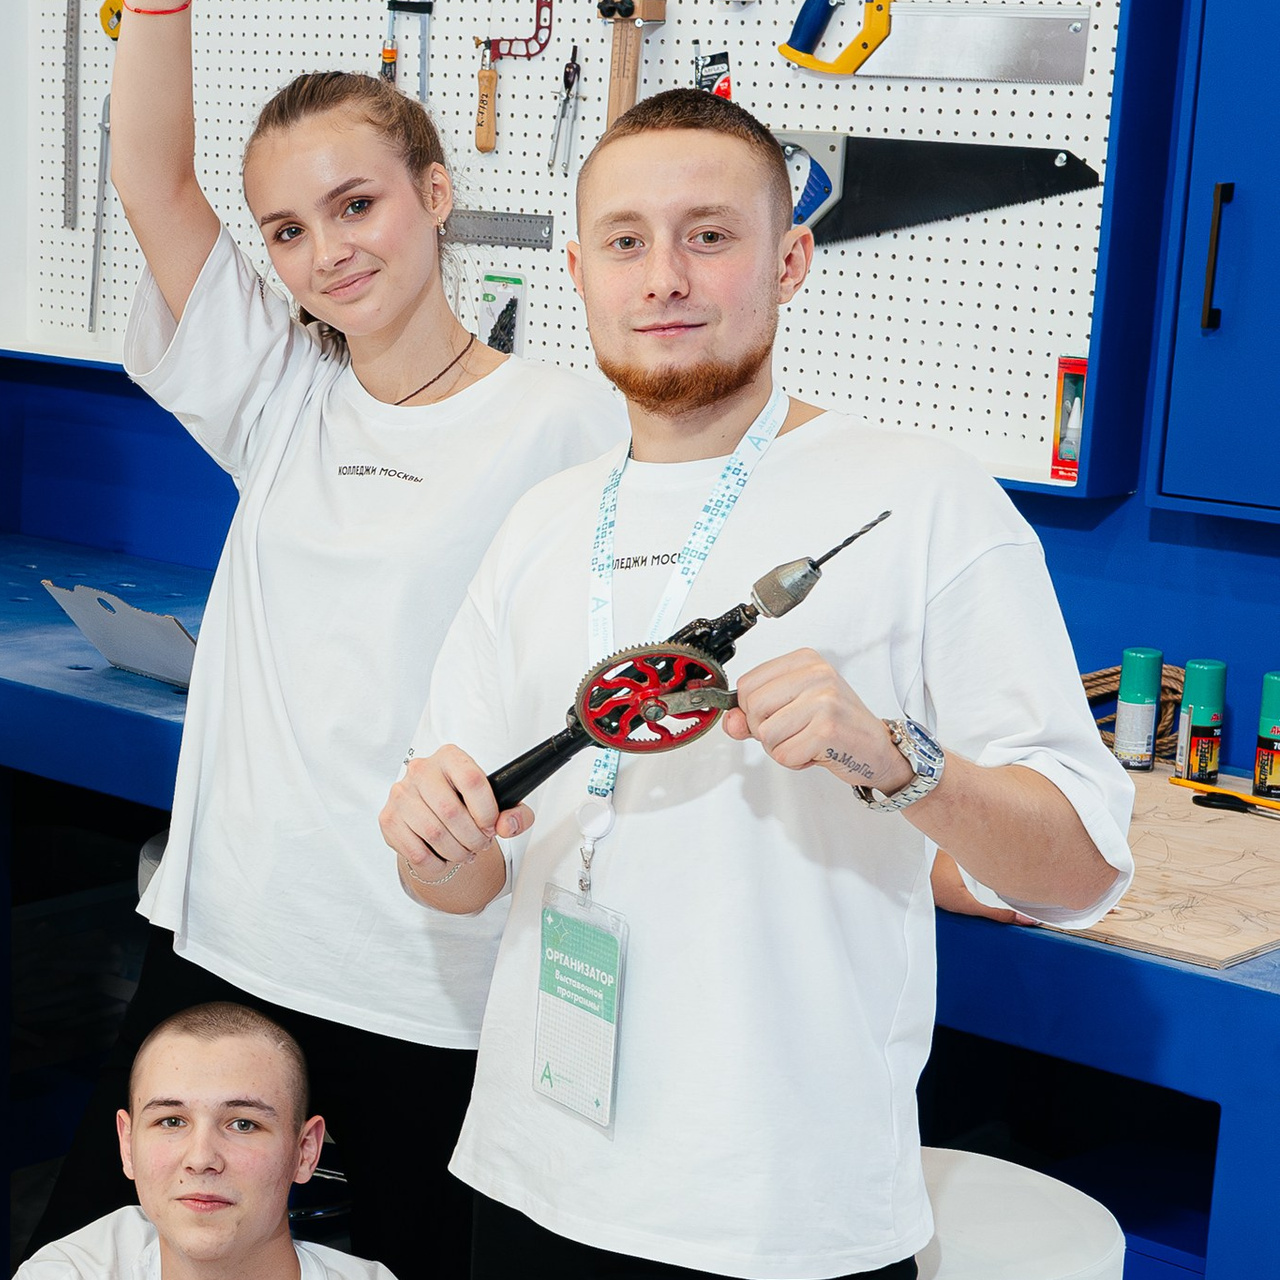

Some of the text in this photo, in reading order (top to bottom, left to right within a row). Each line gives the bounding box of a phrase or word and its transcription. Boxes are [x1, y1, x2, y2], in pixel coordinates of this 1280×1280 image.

[338, 465, 424, 483] КОЛЛЕДЖИ МОСКВЫ
[612, 552, 681, 570] ЛЕДЖИ МОС
[545, 947, 615, 987] ОРГАНИЗАТОР
